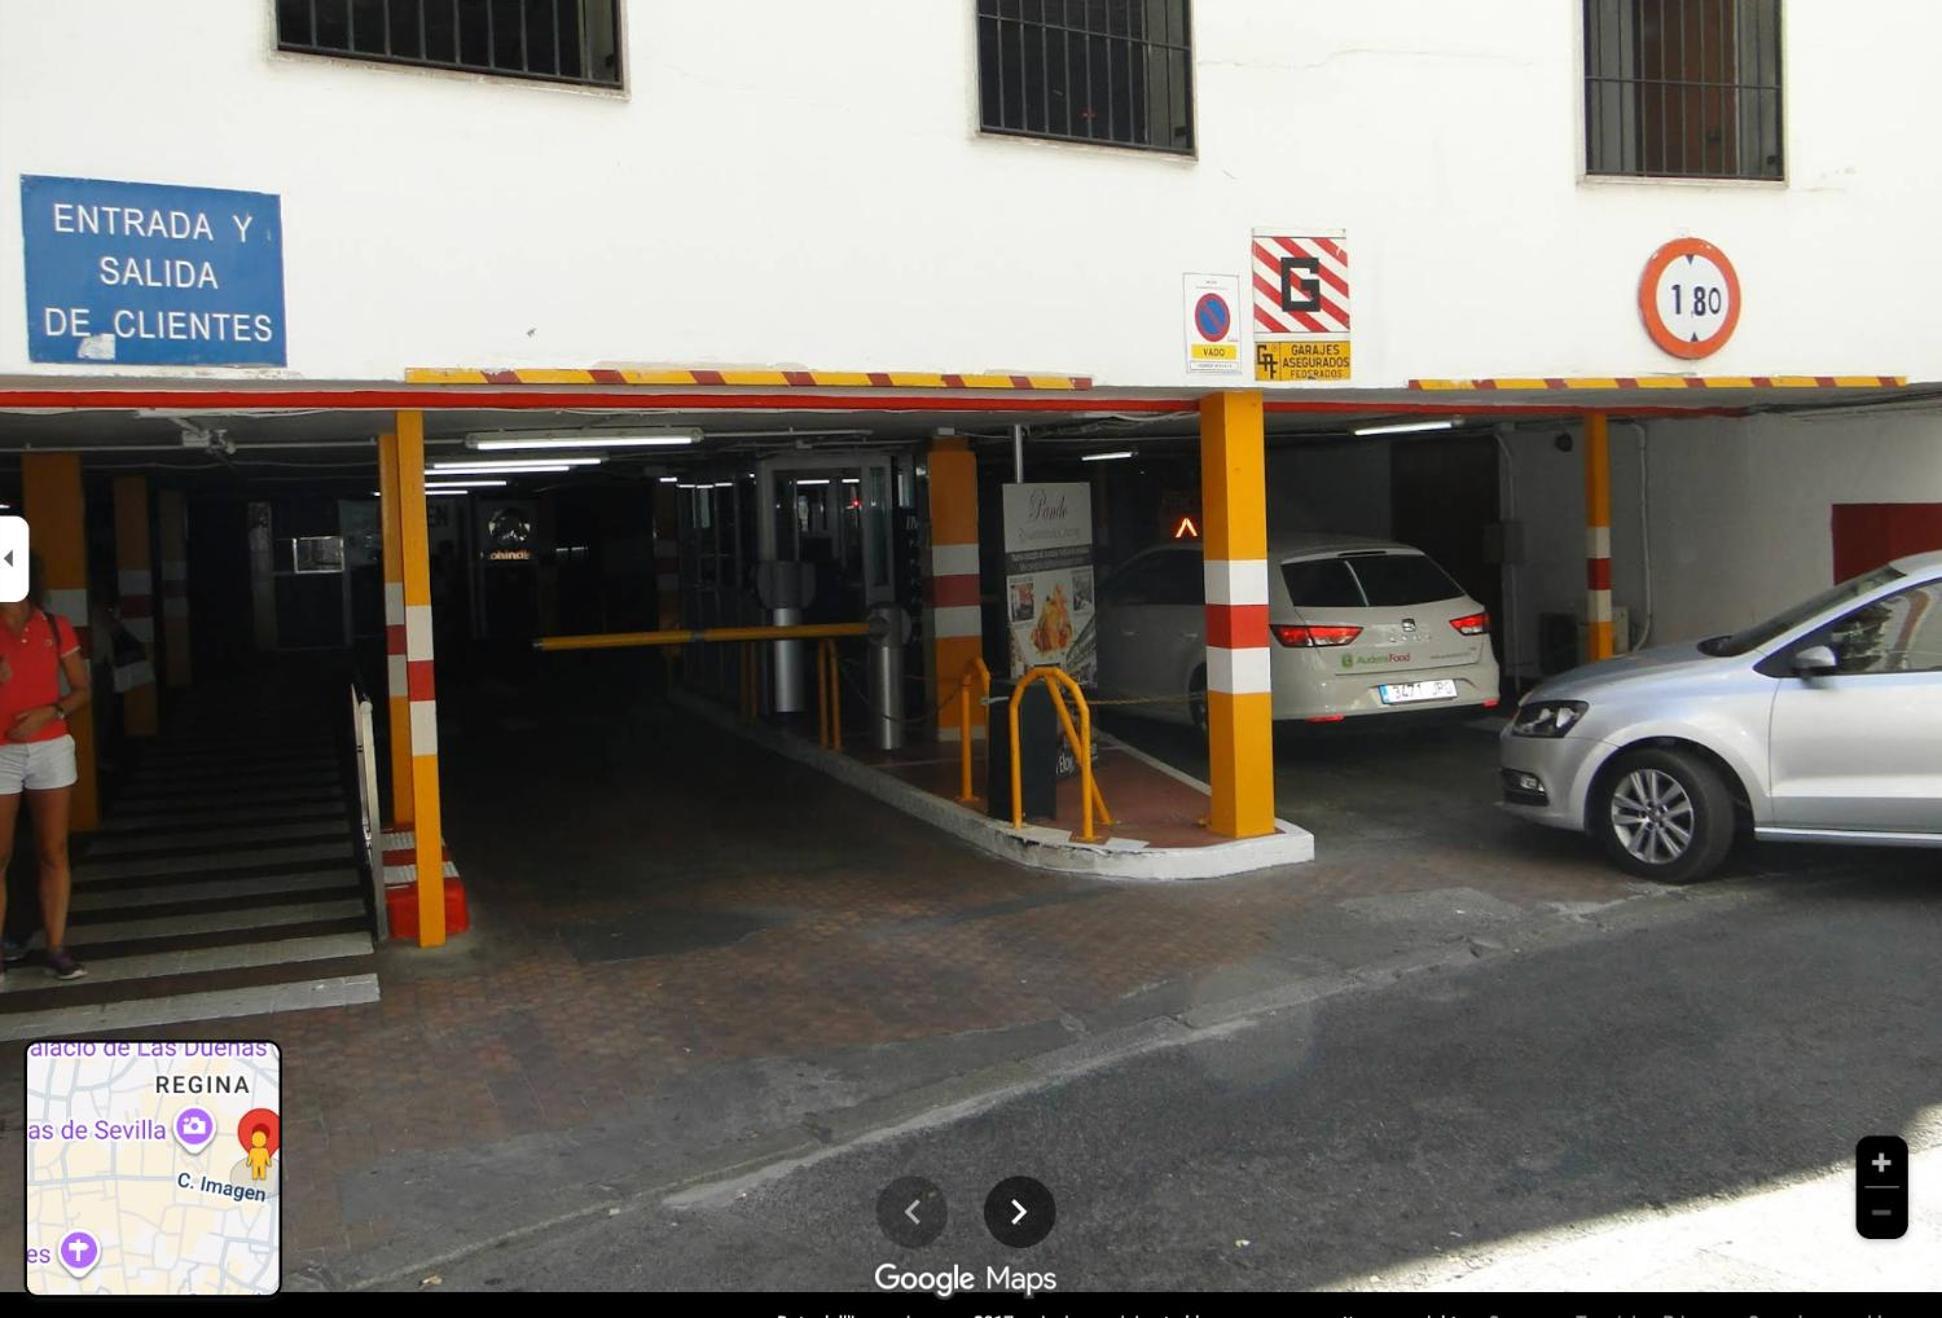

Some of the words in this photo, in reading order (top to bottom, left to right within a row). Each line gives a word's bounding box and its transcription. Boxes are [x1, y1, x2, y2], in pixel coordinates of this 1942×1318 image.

[53, 202, 214, 241] ENTRADA
[232, 215, 254, 243] Y
[99, 255, 219, 289] SALIDA
[1280, 256, 1321, 313] G
[44, 306, 91, 338] DE
[113, 309, 273, 343] CLIENTES
[1202, 347, 1226, 358] VADO
[1291, 343, 1341, 355] GARAJES
[1283, 356, 1349, 368] ASEGURADOS
[1290, 369, 1343, 379] FEDERADOS
